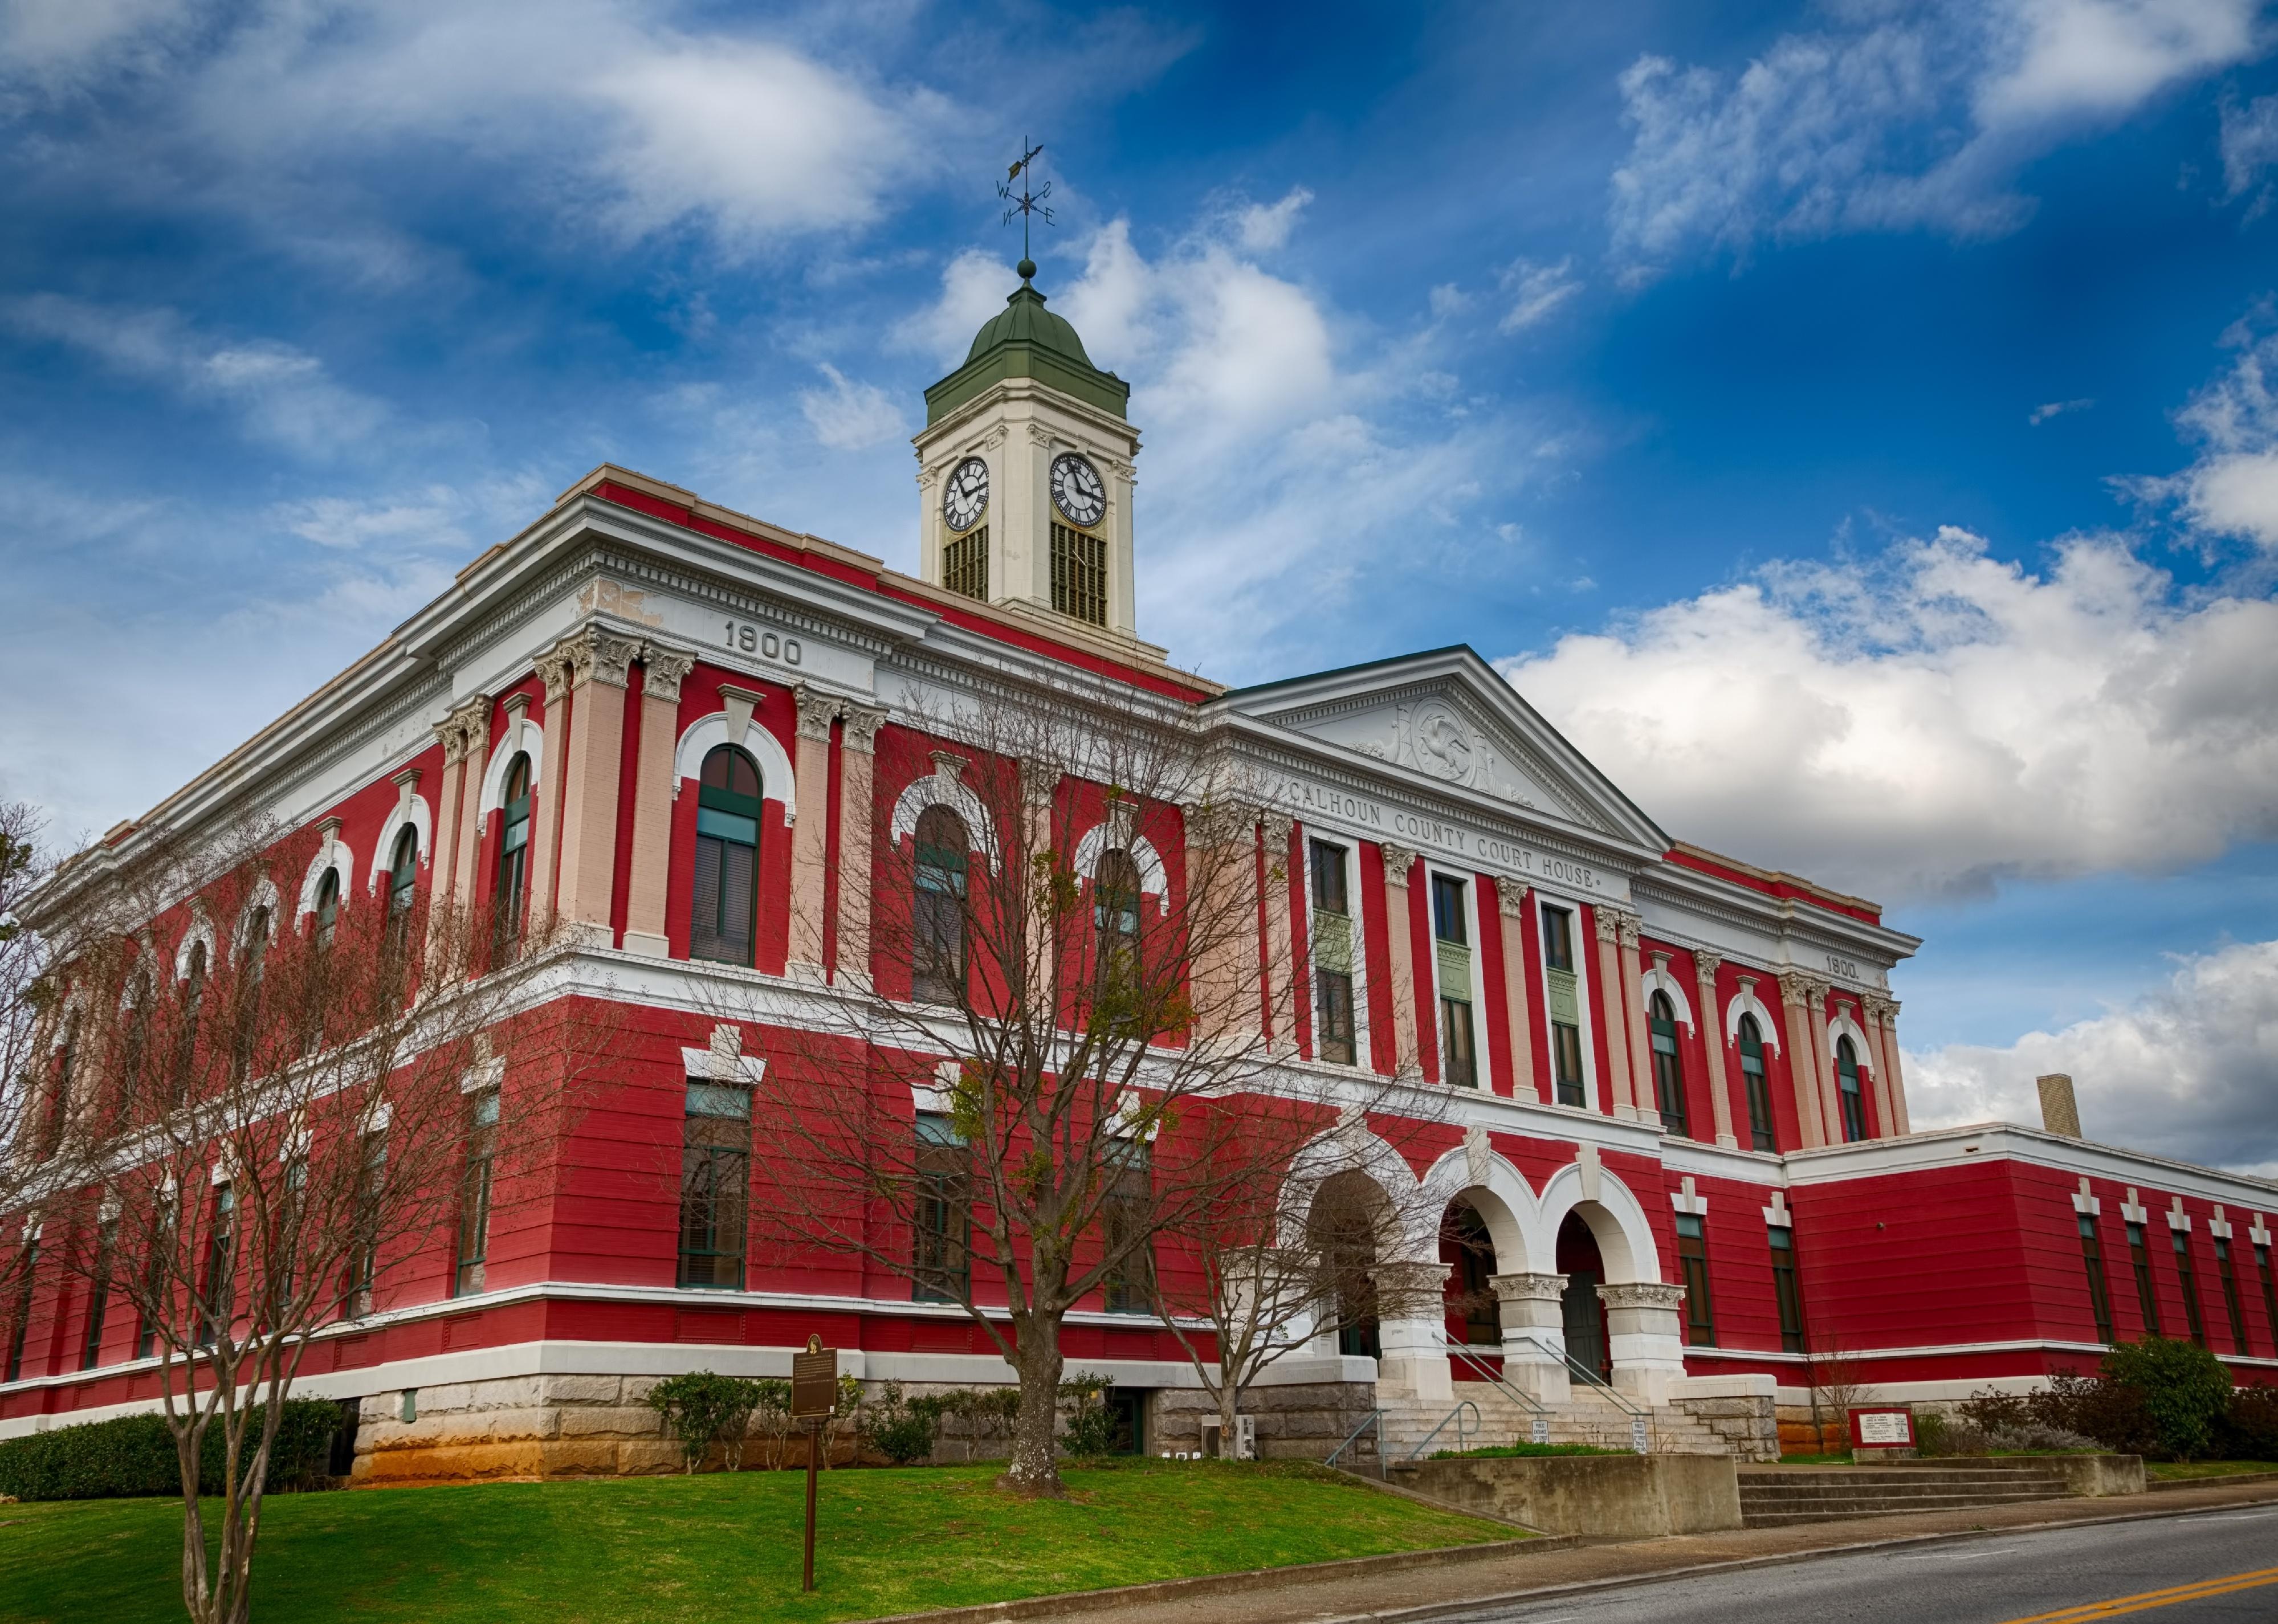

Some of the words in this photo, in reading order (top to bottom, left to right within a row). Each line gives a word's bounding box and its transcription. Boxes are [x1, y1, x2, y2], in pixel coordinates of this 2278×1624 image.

[1045, 207, 1056, 227] E
[1289, 782, 1381, 826] CALHOUN
[1395, 814, 1465, 850] COUNTY
[1477, 839, 1532, 870] COURT
